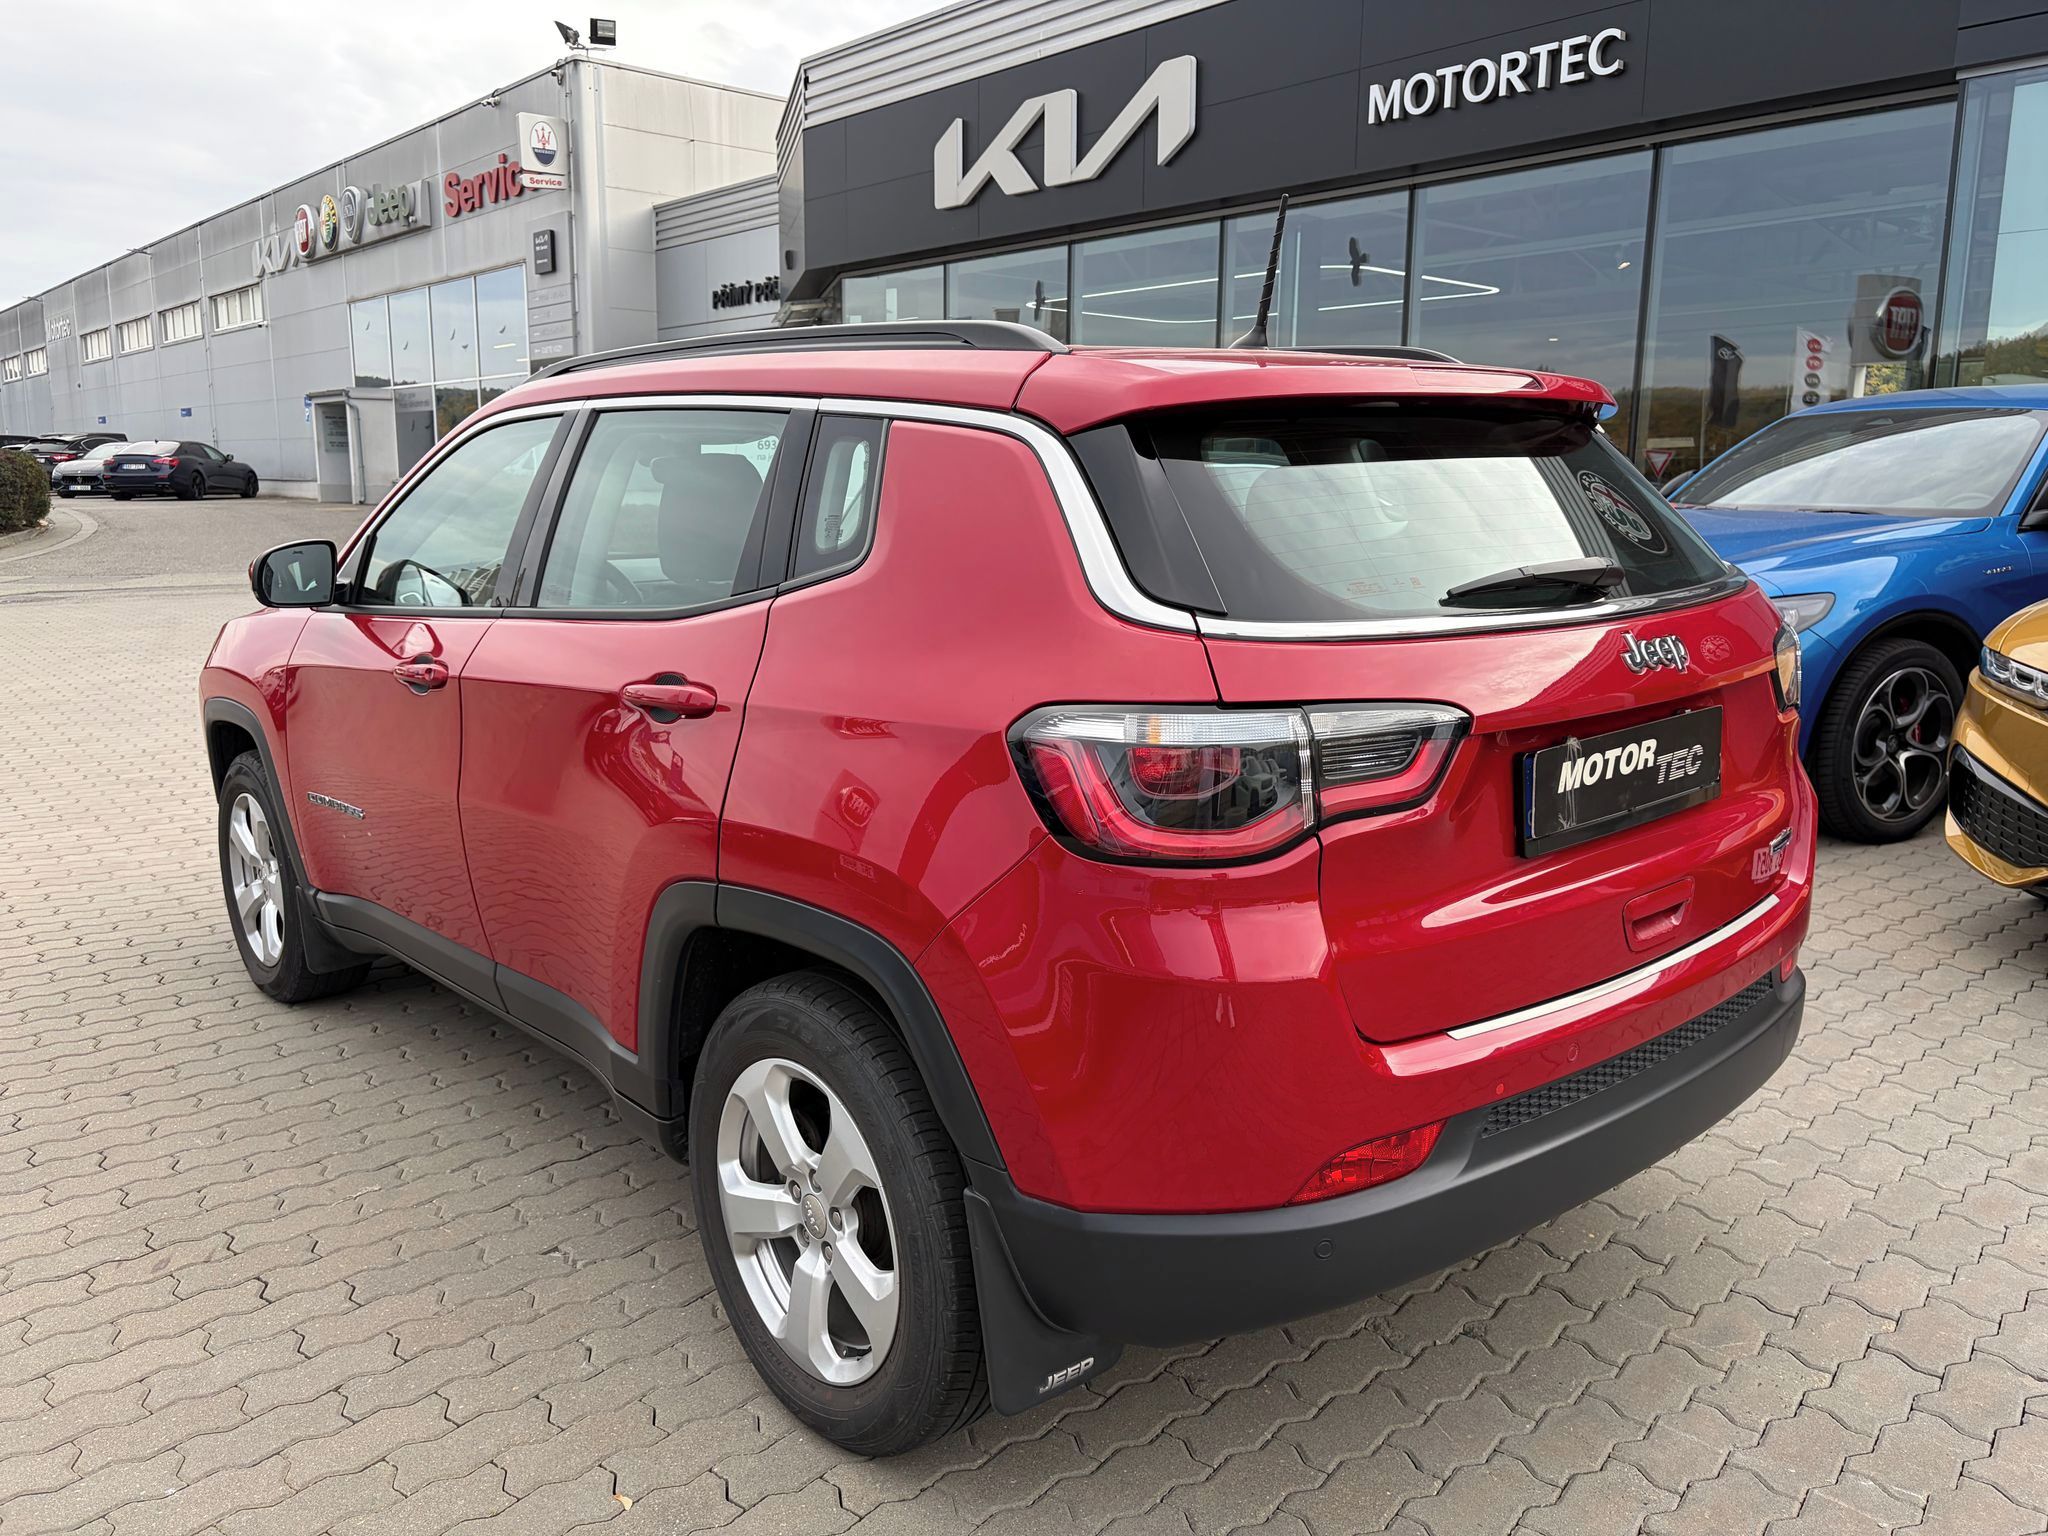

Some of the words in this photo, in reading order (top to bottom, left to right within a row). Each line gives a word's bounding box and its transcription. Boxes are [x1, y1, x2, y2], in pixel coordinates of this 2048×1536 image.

[1368, 27, 1627, 125] MOTORTEC
[934, 55, 1198, 210] KIA
[444, 153, 536, 218] Servic
[529, 176, 563, 187] Service
[366, 184, 412, 227] Jeep
[253, 231, 300, 278] KIA
[712, 280, 753, 310] PŘÍMÝ
[757, 440, 777, 450] 693
[1620, 630, 1690, 675] Jeep
[307, 791, 366, 820] COMPASS
[1039, 1356, 1095, 1394] JEEP
